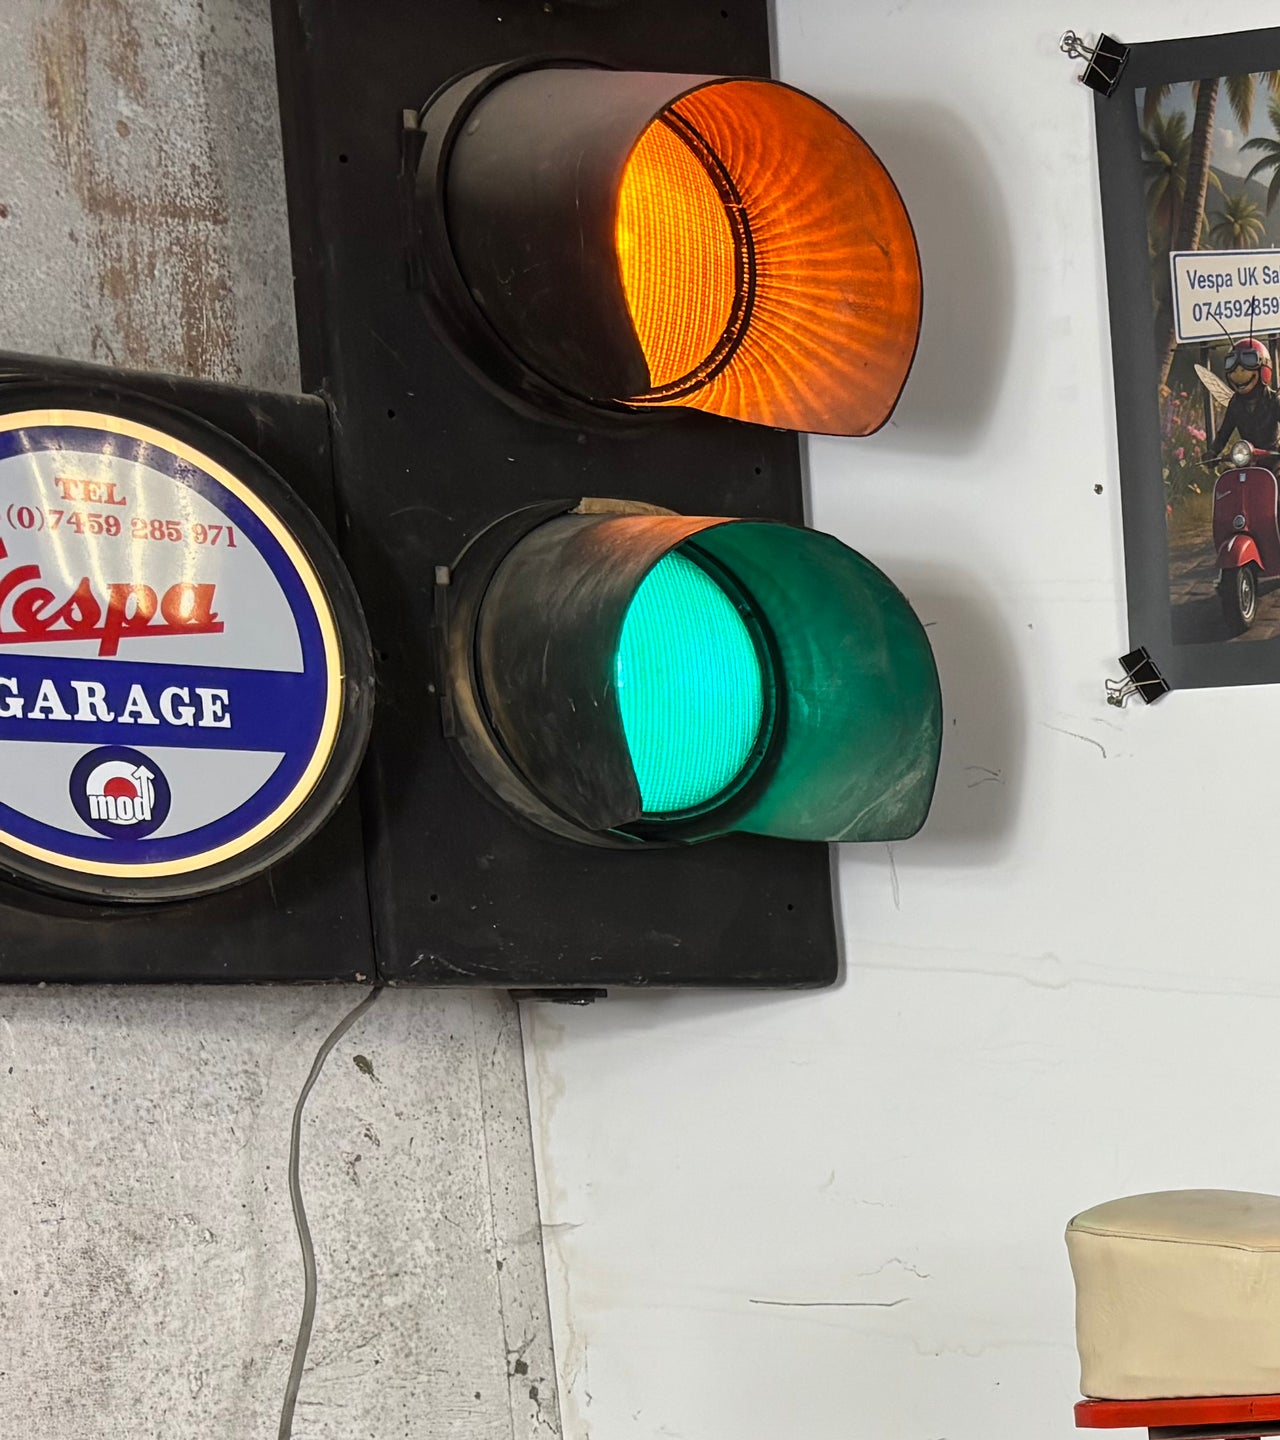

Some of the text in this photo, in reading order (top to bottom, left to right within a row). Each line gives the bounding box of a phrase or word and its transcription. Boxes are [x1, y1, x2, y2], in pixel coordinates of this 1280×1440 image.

[1186, 269, 1233, 293] Vespa
[1237, 266, 1259, 287] UK
[55, 477, 127, 506] TEL
[6, 504, 238, 548] (0)7459 285 971
[0, 677, 232, 728] GARAGE
[88, 772, 152, 821] mod
